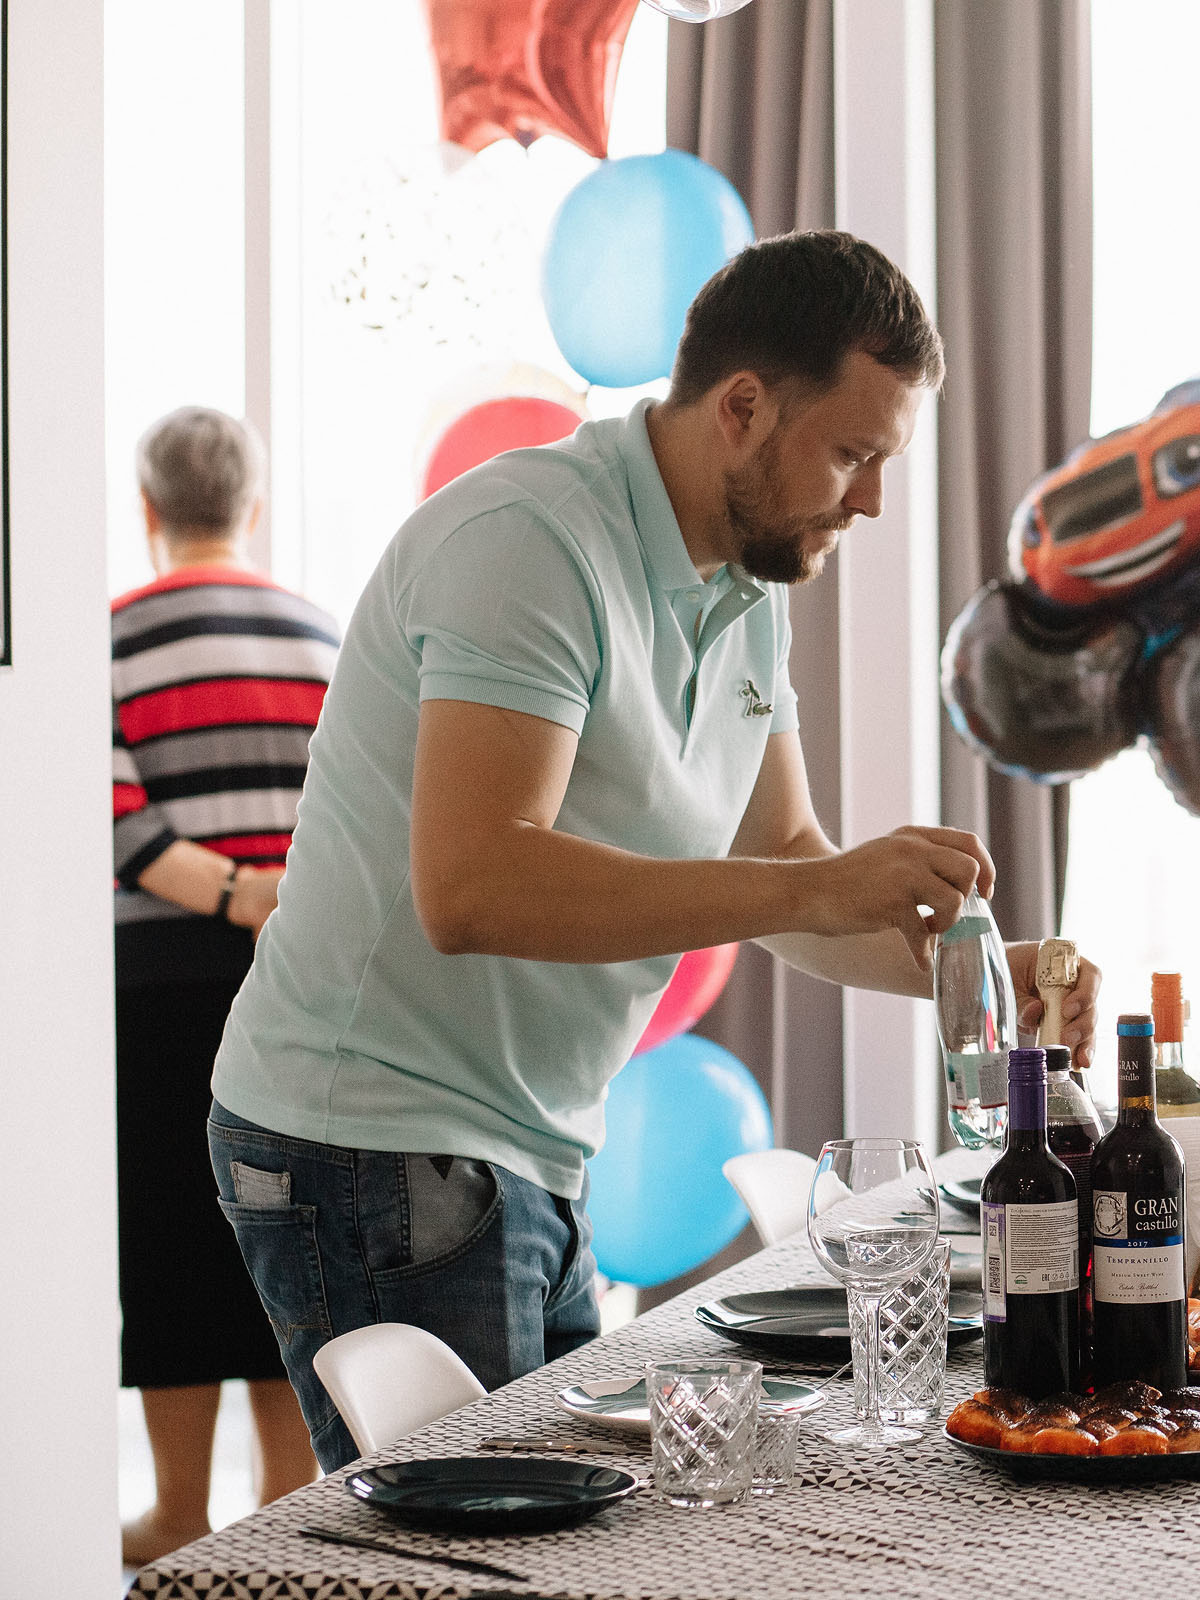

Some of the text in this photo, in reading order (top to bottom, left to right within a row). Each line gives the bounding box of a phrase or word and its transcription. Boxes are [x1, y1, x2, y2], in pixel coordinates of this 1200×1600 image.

[1119, 1072, 1140, 1081] astillo
[1134, 1196, 1179, 1217] GRAN
[1135, 1215, 1178, 1231] castillo
